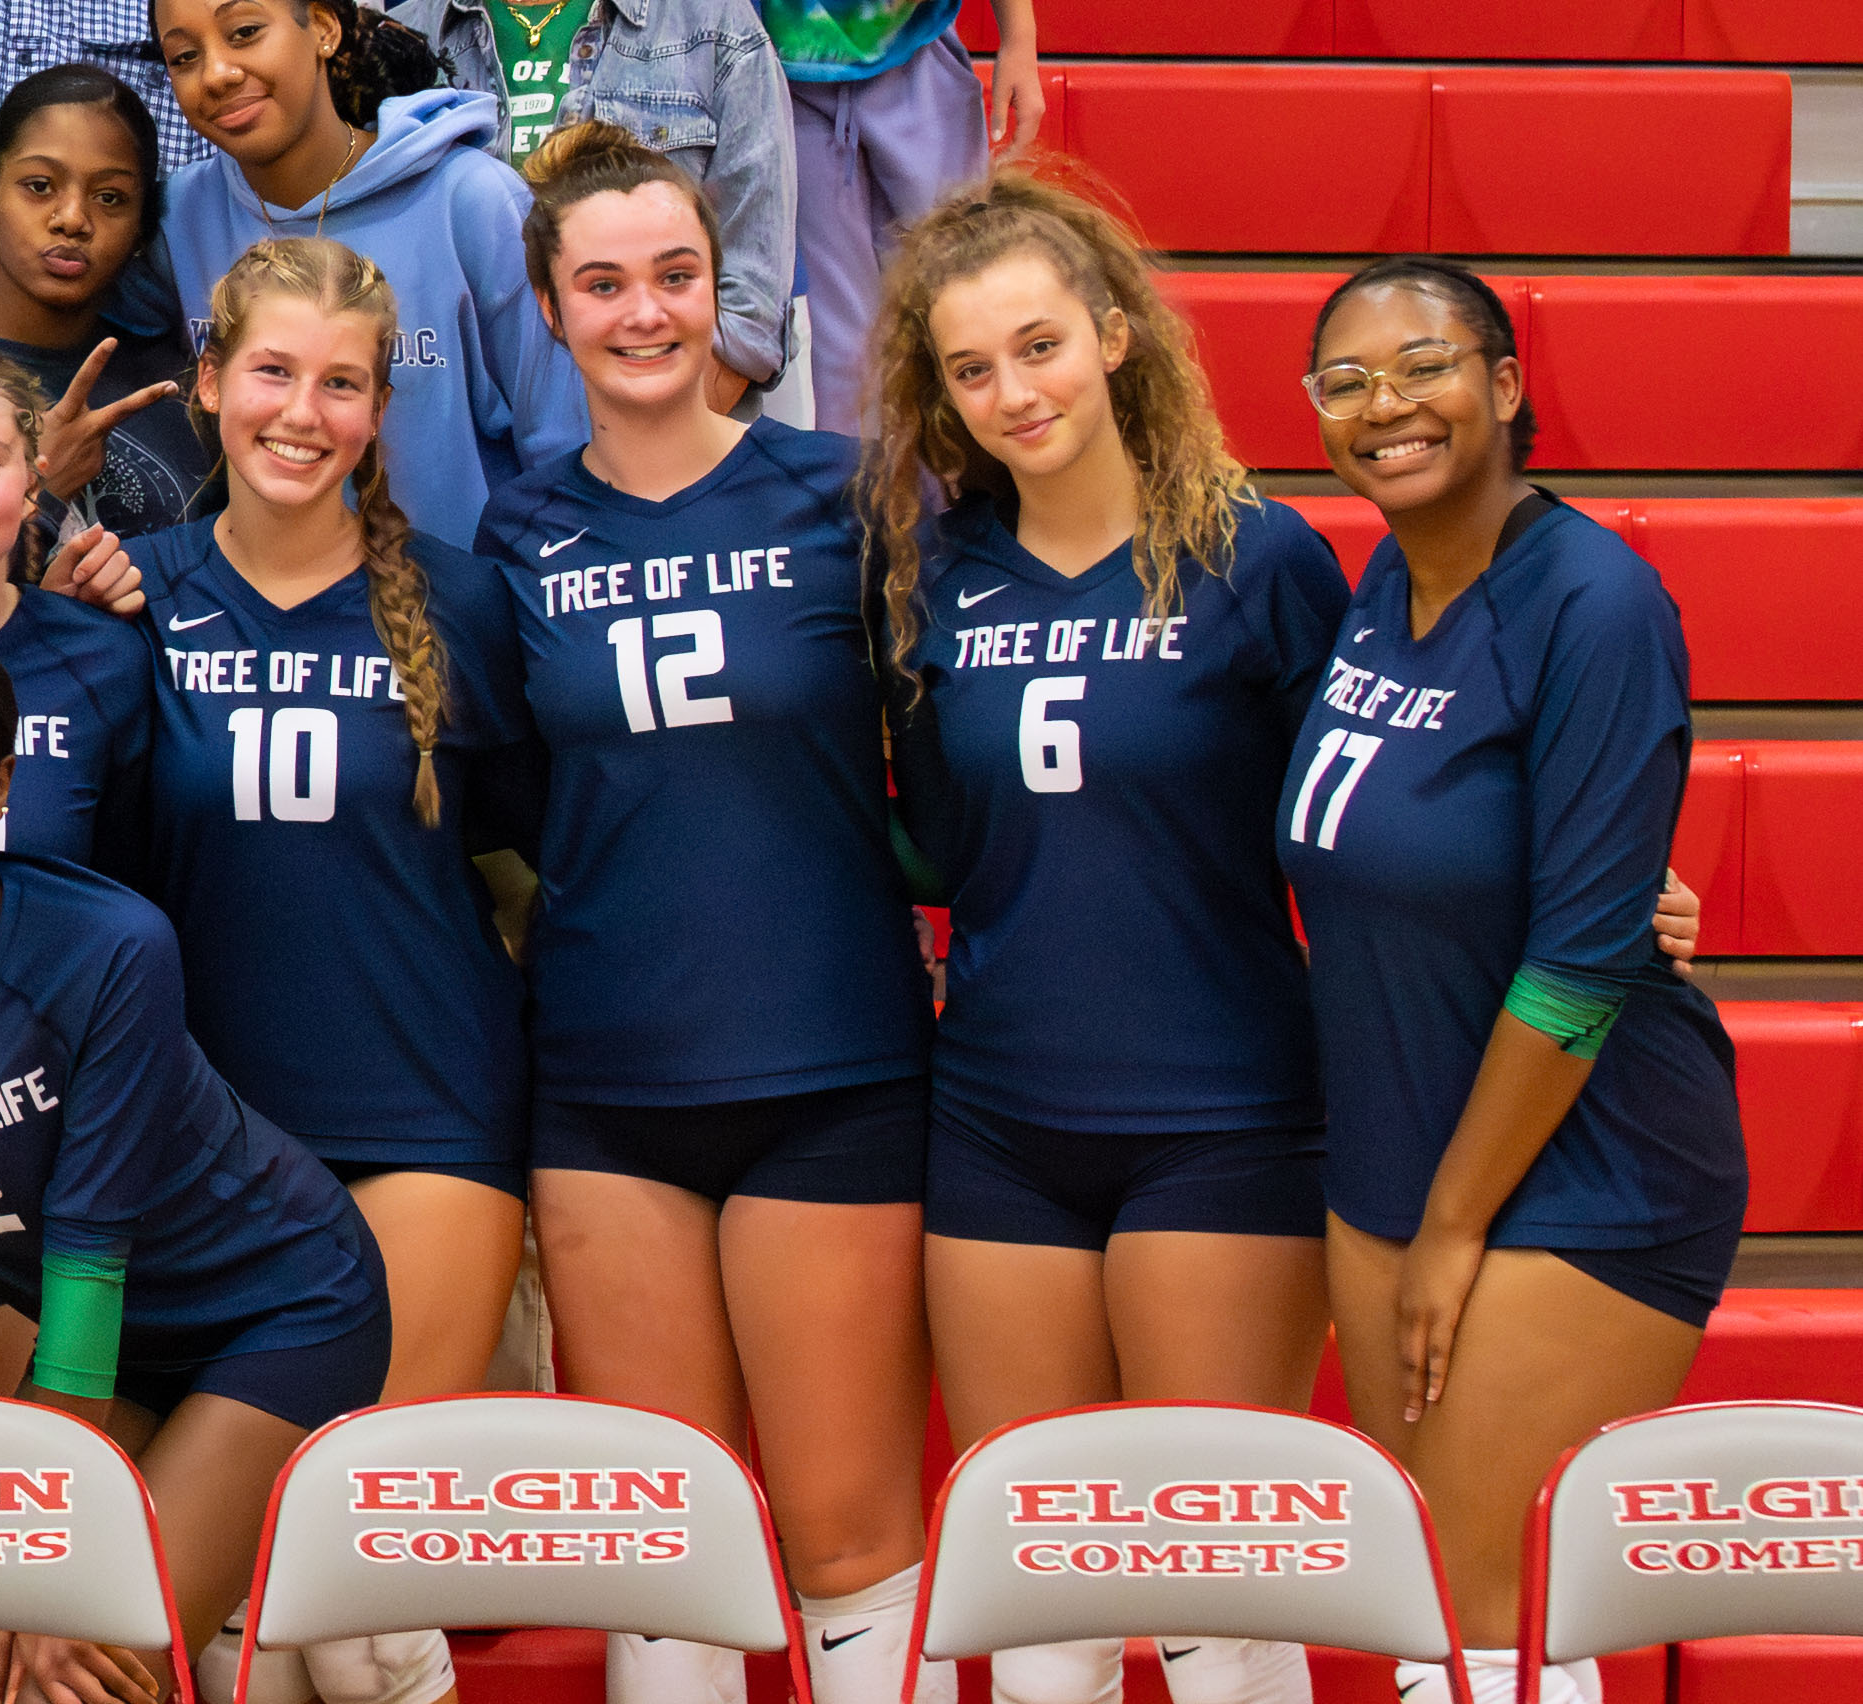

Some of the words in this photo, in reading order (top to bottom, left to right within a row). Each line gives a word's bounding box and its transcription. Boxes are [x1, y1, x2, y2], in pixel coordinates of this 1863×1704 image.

[513, 60, 552, 81] OF
[540, 562, 633, 618] TREE
[644, 556, 693, 601] OF
[706, 547, 793, 594] LIFE
[955, 622, 1039, 668] TREE
[1045, 618, 1096, 662] OF
[1101, 616, 1187, 660] LIFE
[165, 648, 258, 693] TREE
[269, 651, 319, 693] OF
[607, 609, 734, 734] 12
[1323, 656, 1375, 715] TREE
[1387, 687, 1457, 730] LIFE
[15, 715, 70, 758] IFE
[1019, 675, 1087, 793] 6
[227, 707, 338, 822] 10
[1290, 727, 1384, 851] 17
[349, 1466, 690, 1515] ELGIN
[1005, 1479, 1353, 1527] ELGIN
[1607, 1476, 1863, 1527] ELGI
[354, 1526, 688, 1566] COMETS
[1012, 1538, 1350, 1578] COMETS
[1623, 1536, 1863, 1575] COMET
